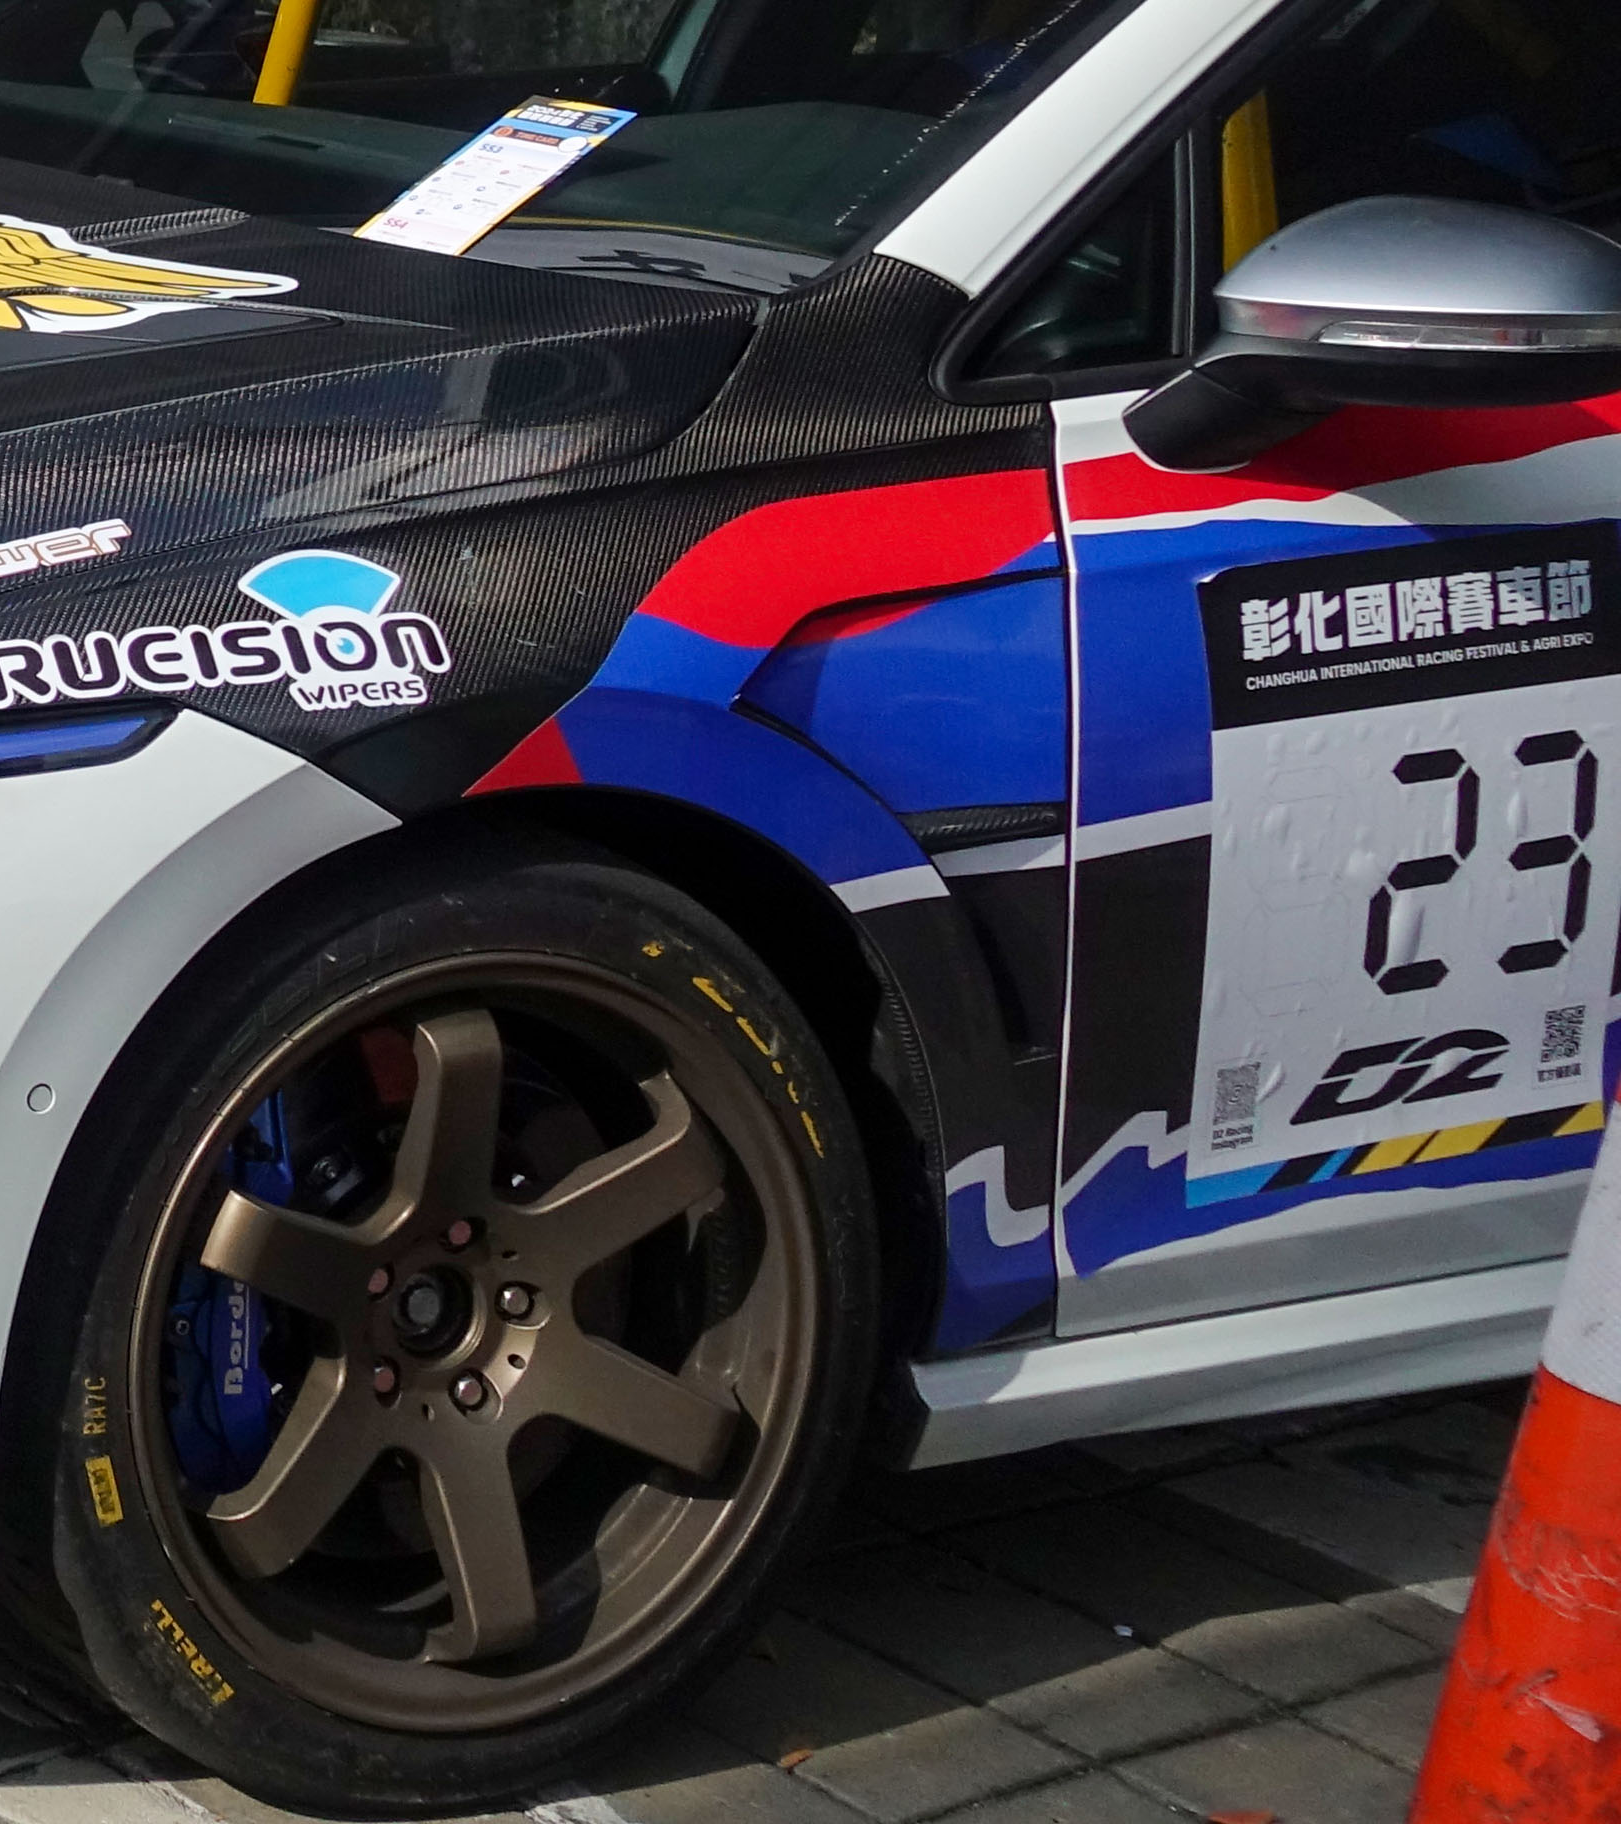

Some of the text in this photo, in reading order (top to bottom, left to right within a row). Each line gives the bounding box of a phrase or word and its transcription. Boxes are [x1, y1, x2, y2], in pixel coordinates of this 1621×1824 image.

[1240, 559, 1592, 662] 彰化國際賽車節
[1246, 631, 1594, 691] CHANGHUA INTERNATIONAL RACING FESTIVAL & AGRI EXPO
[299, 678, 428, 709] WIPERS
[1363, 729, 1598, 995] 23
[83, 1377, 106, 1435] RA7C
